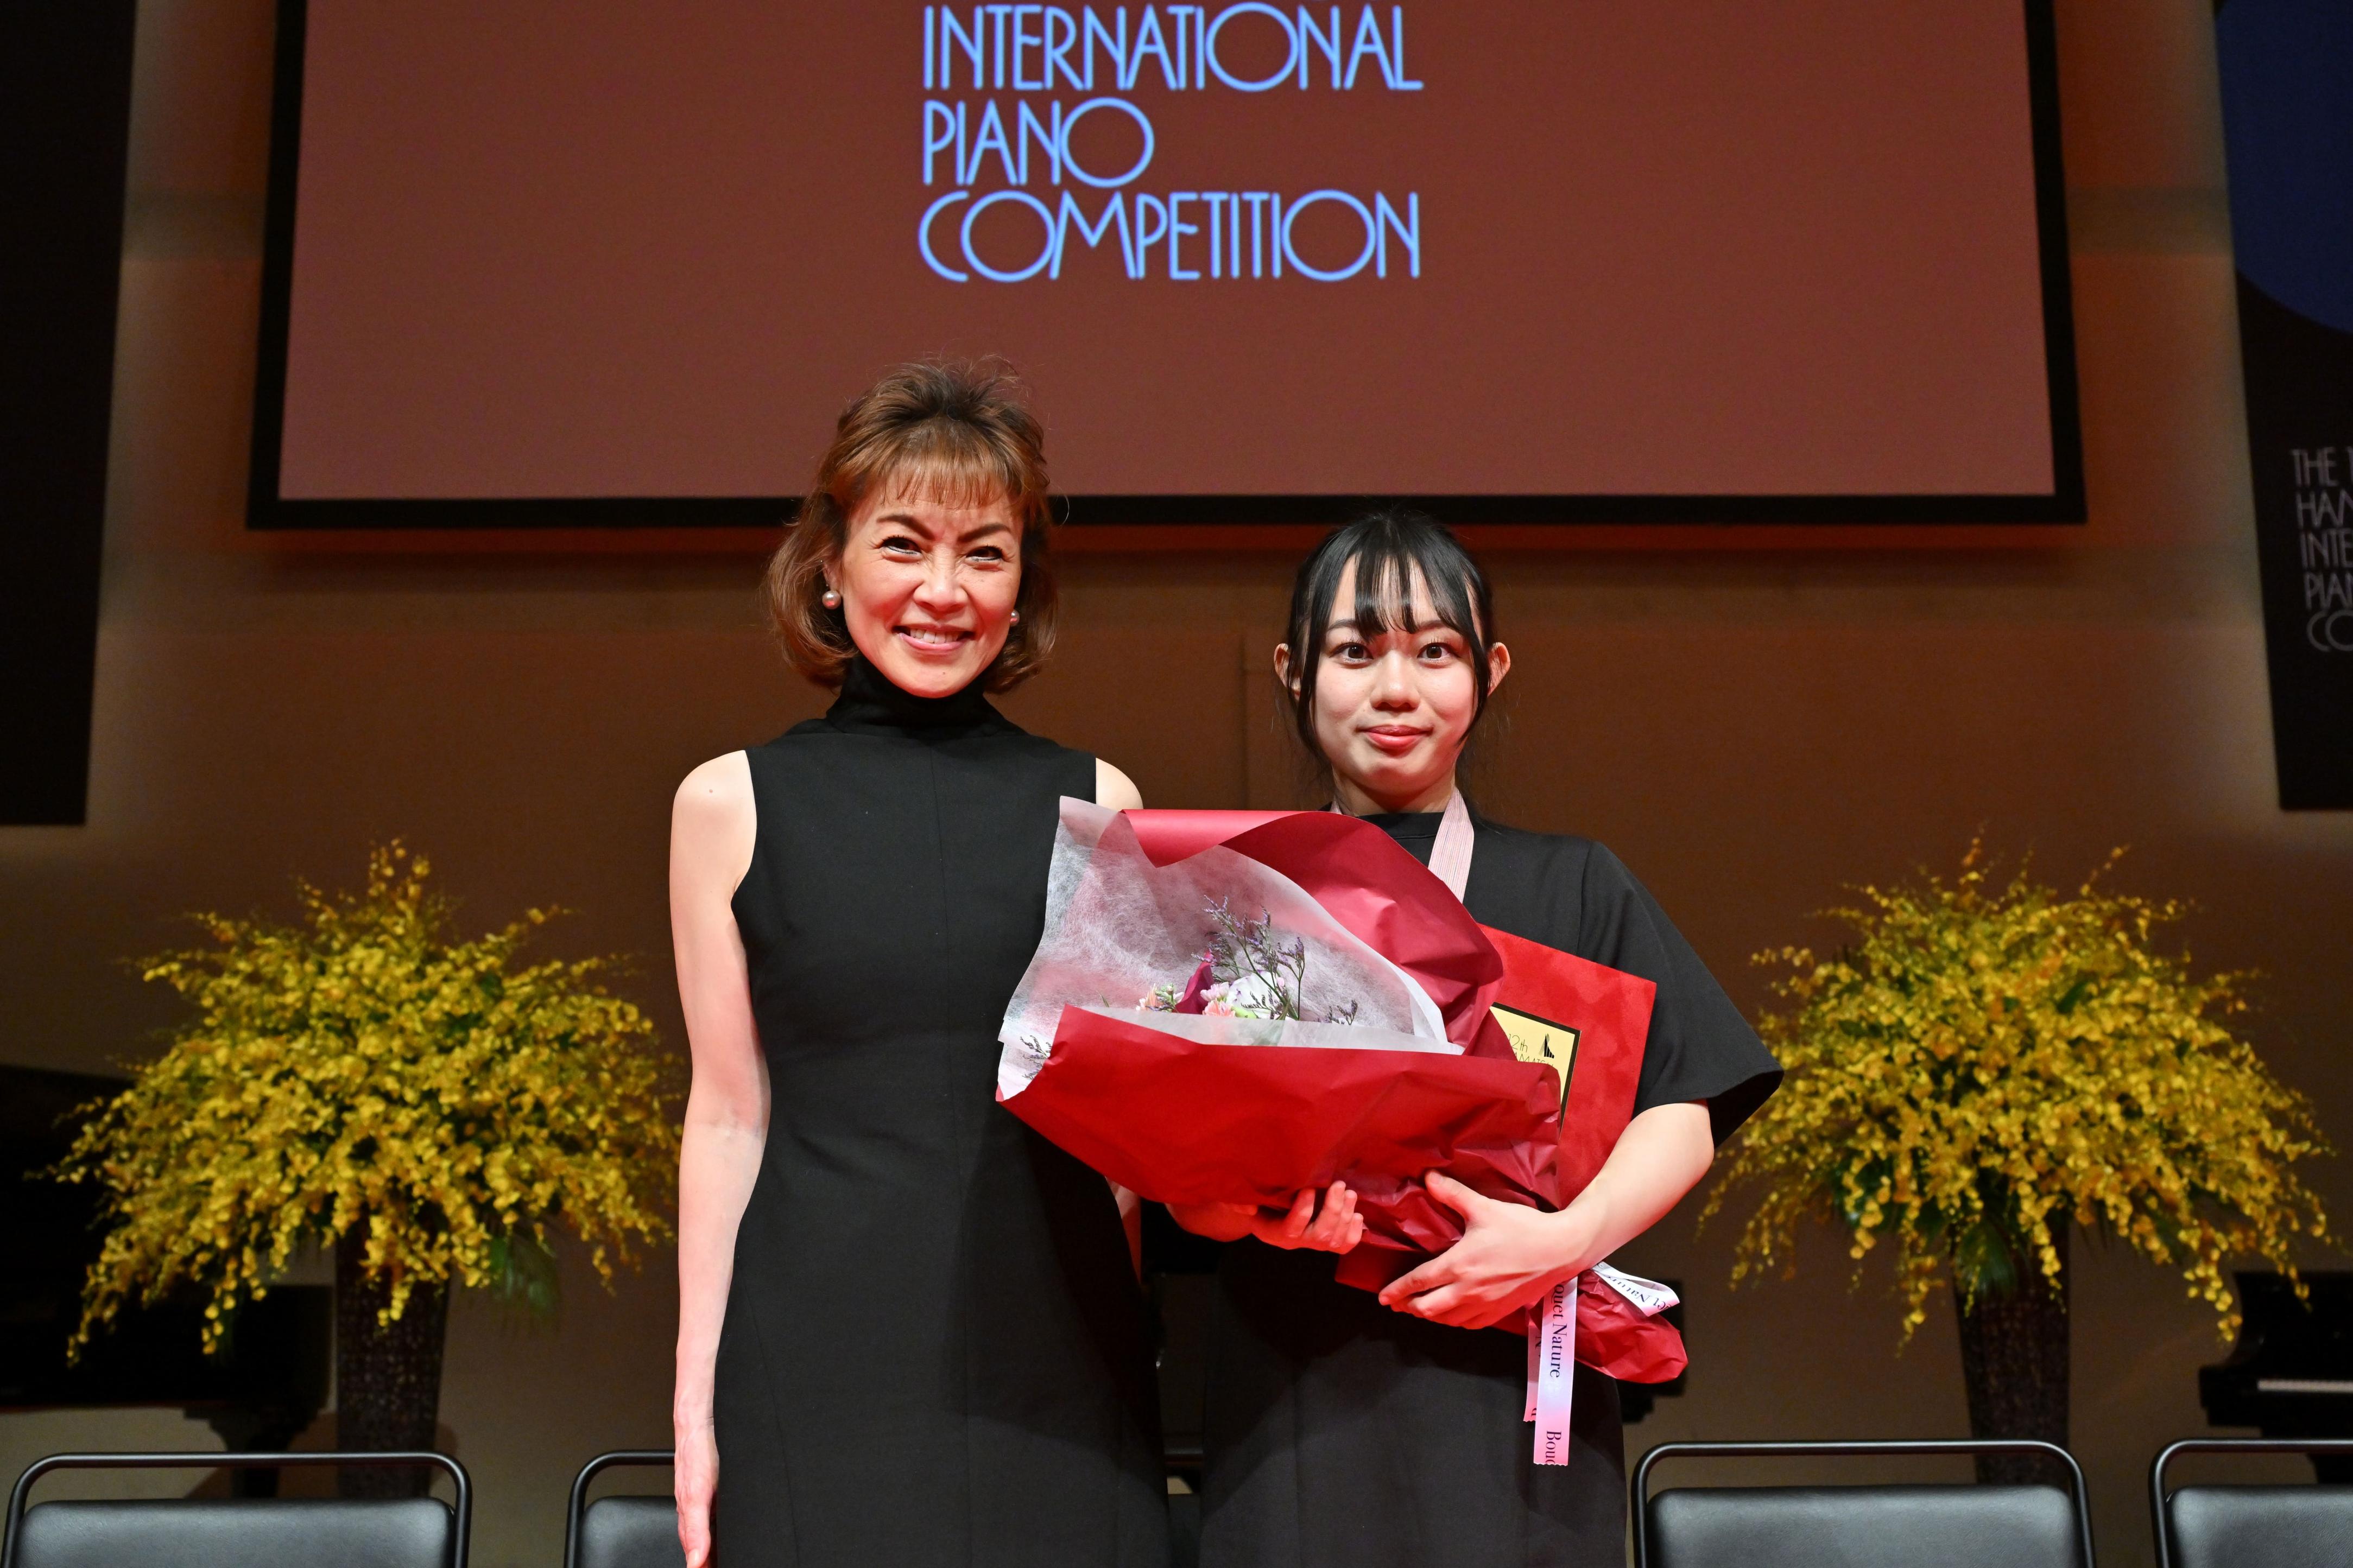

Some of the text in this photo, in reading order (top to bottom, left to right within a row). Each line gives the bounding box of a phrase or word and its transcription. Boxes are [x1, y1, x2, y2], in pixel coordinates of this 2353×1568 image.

[924, 2, 1424, 92] INTERNATIONAL
[924, 97, 1155, 188] PIANO
[919, 189, 1420, 282] COMPETITION
[2291, 447, 2338, 486] THE
[1549, 1323, 1567, 1378] Nature
